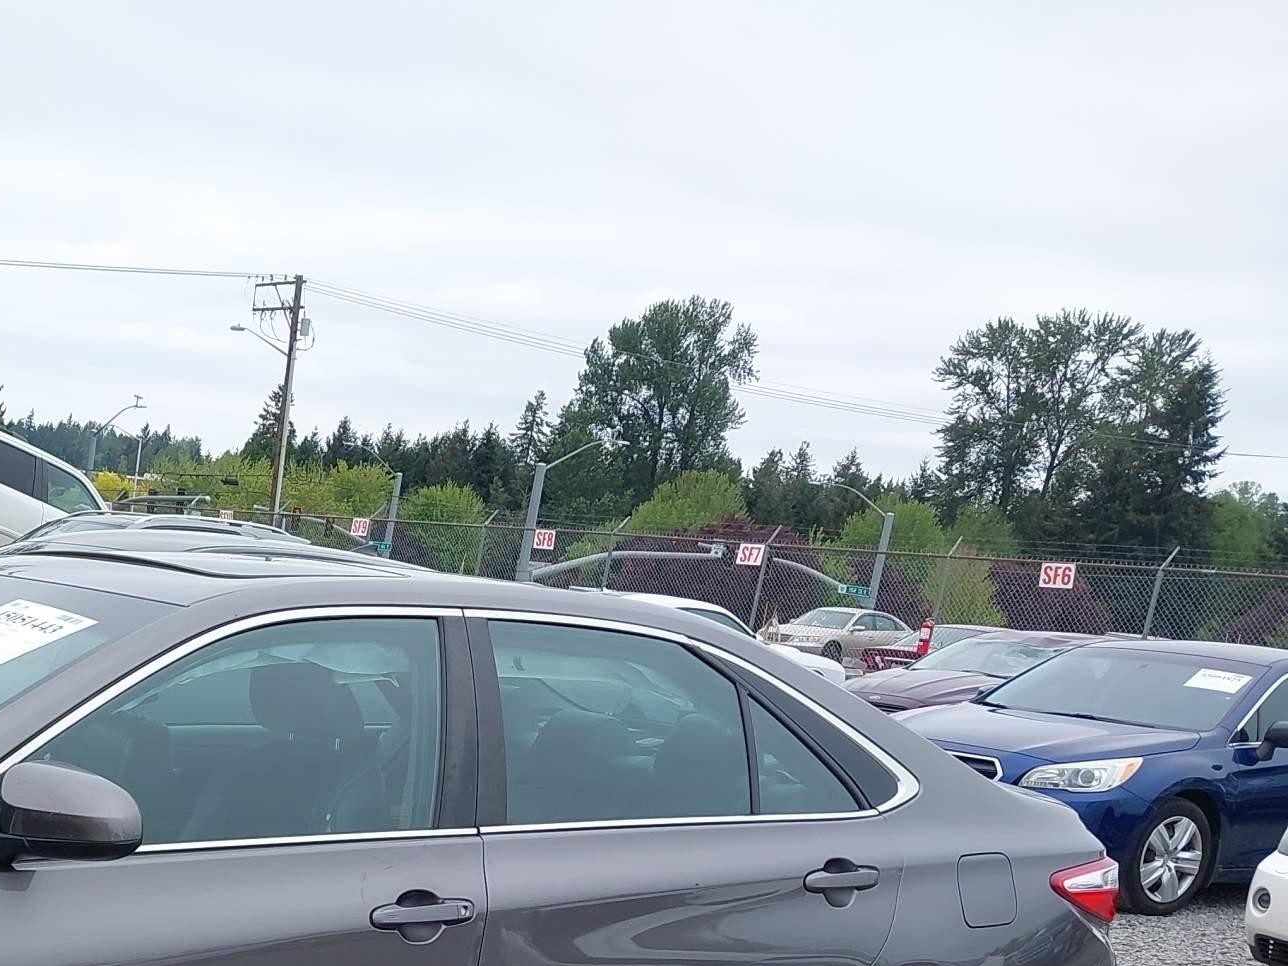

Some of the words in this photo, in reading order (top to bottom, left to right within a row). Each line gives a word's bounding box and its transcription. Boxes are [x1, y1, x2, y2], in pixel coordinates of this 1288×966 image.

[353, 520, 367, 533] SF9
[536, 531, 553, 547] SF8
[740, 546, 762, 563] SF7
[1042, 565, 1072, 586] SF6
